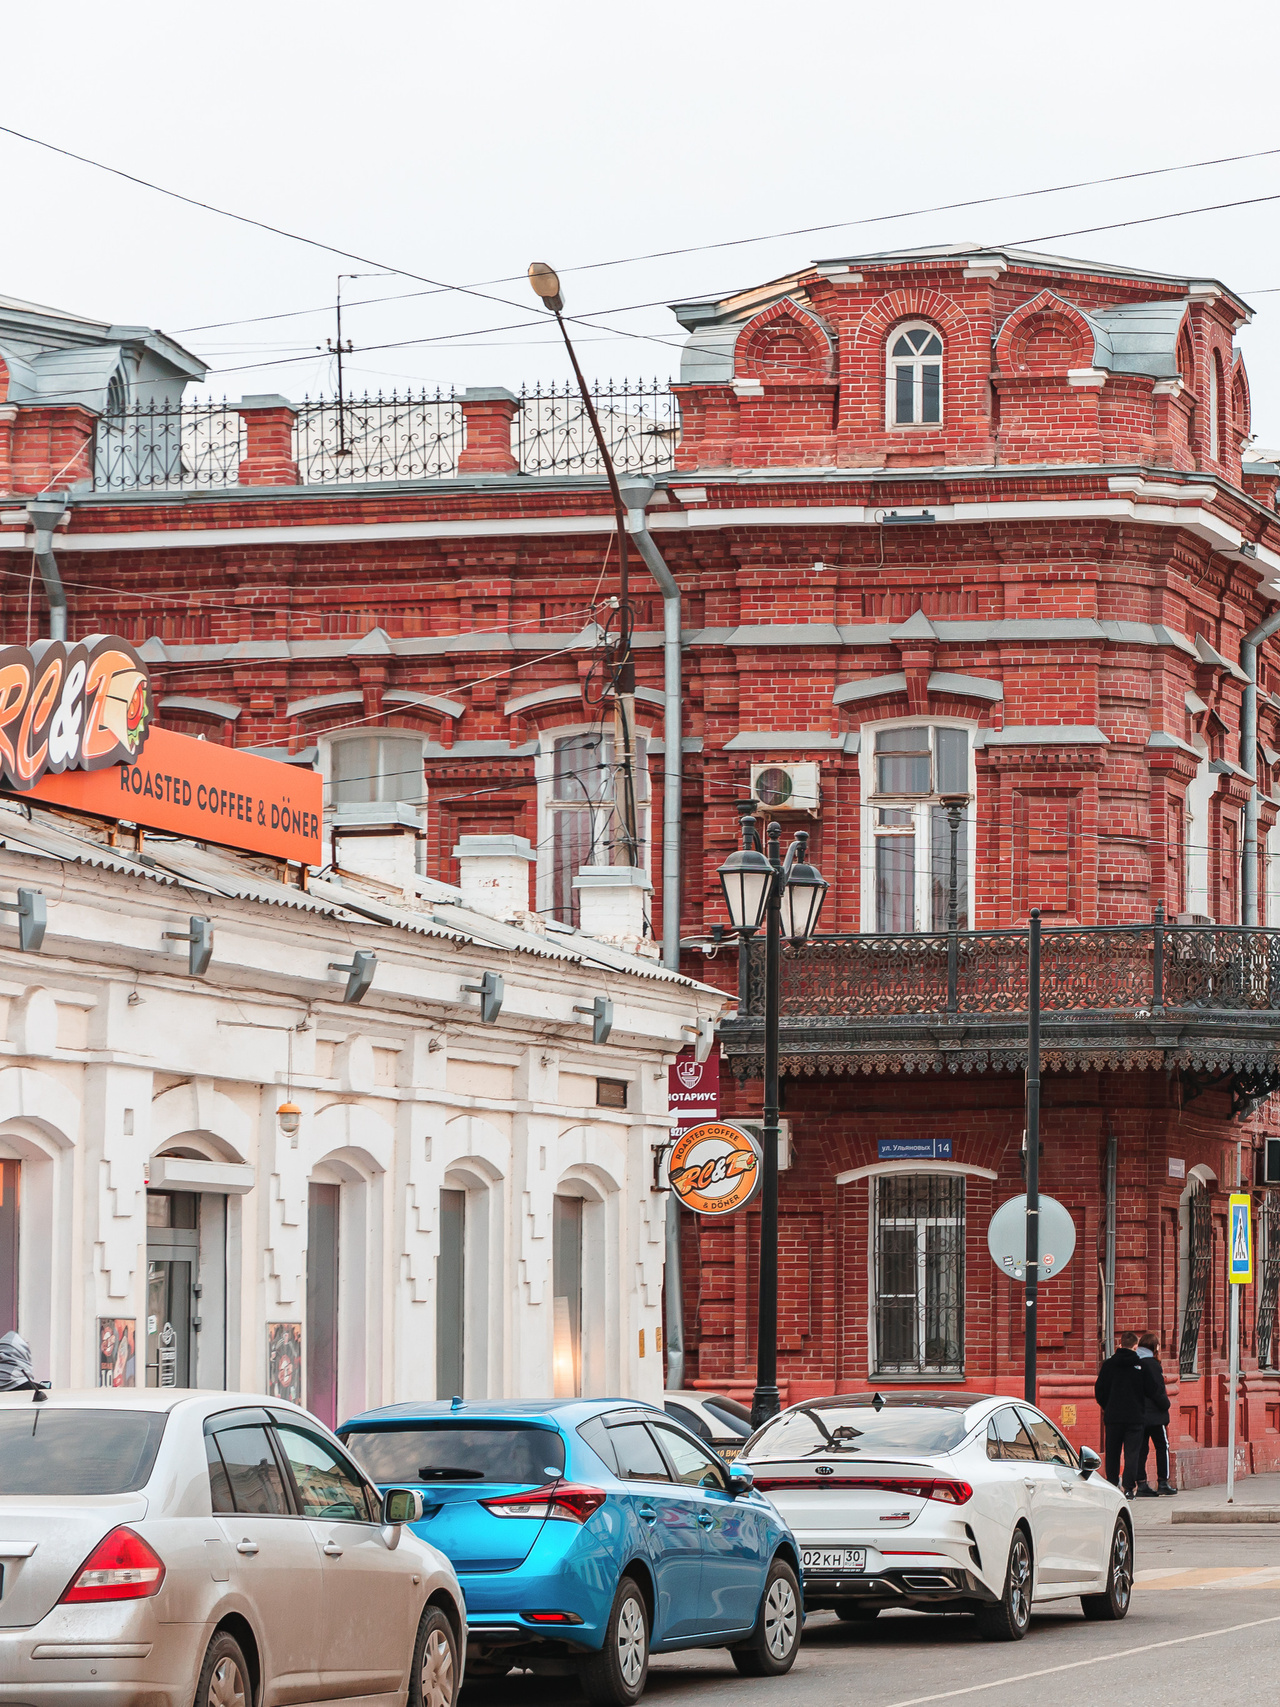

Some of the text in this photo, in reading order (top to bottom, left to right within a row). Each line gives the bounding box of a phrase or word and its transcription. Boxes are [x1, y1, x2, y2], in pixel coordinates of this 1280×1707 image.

[120, 765, 319, 840] ROASTED COFFEE & DÖNER
[675, 1127, 739, 1160] ROASTED COFFEE
[937, 1143, 950, 1153] 14
[711, 1194, 740, 1209] DÖNER
[800, 1550, 860, 1566] 02КН 30
